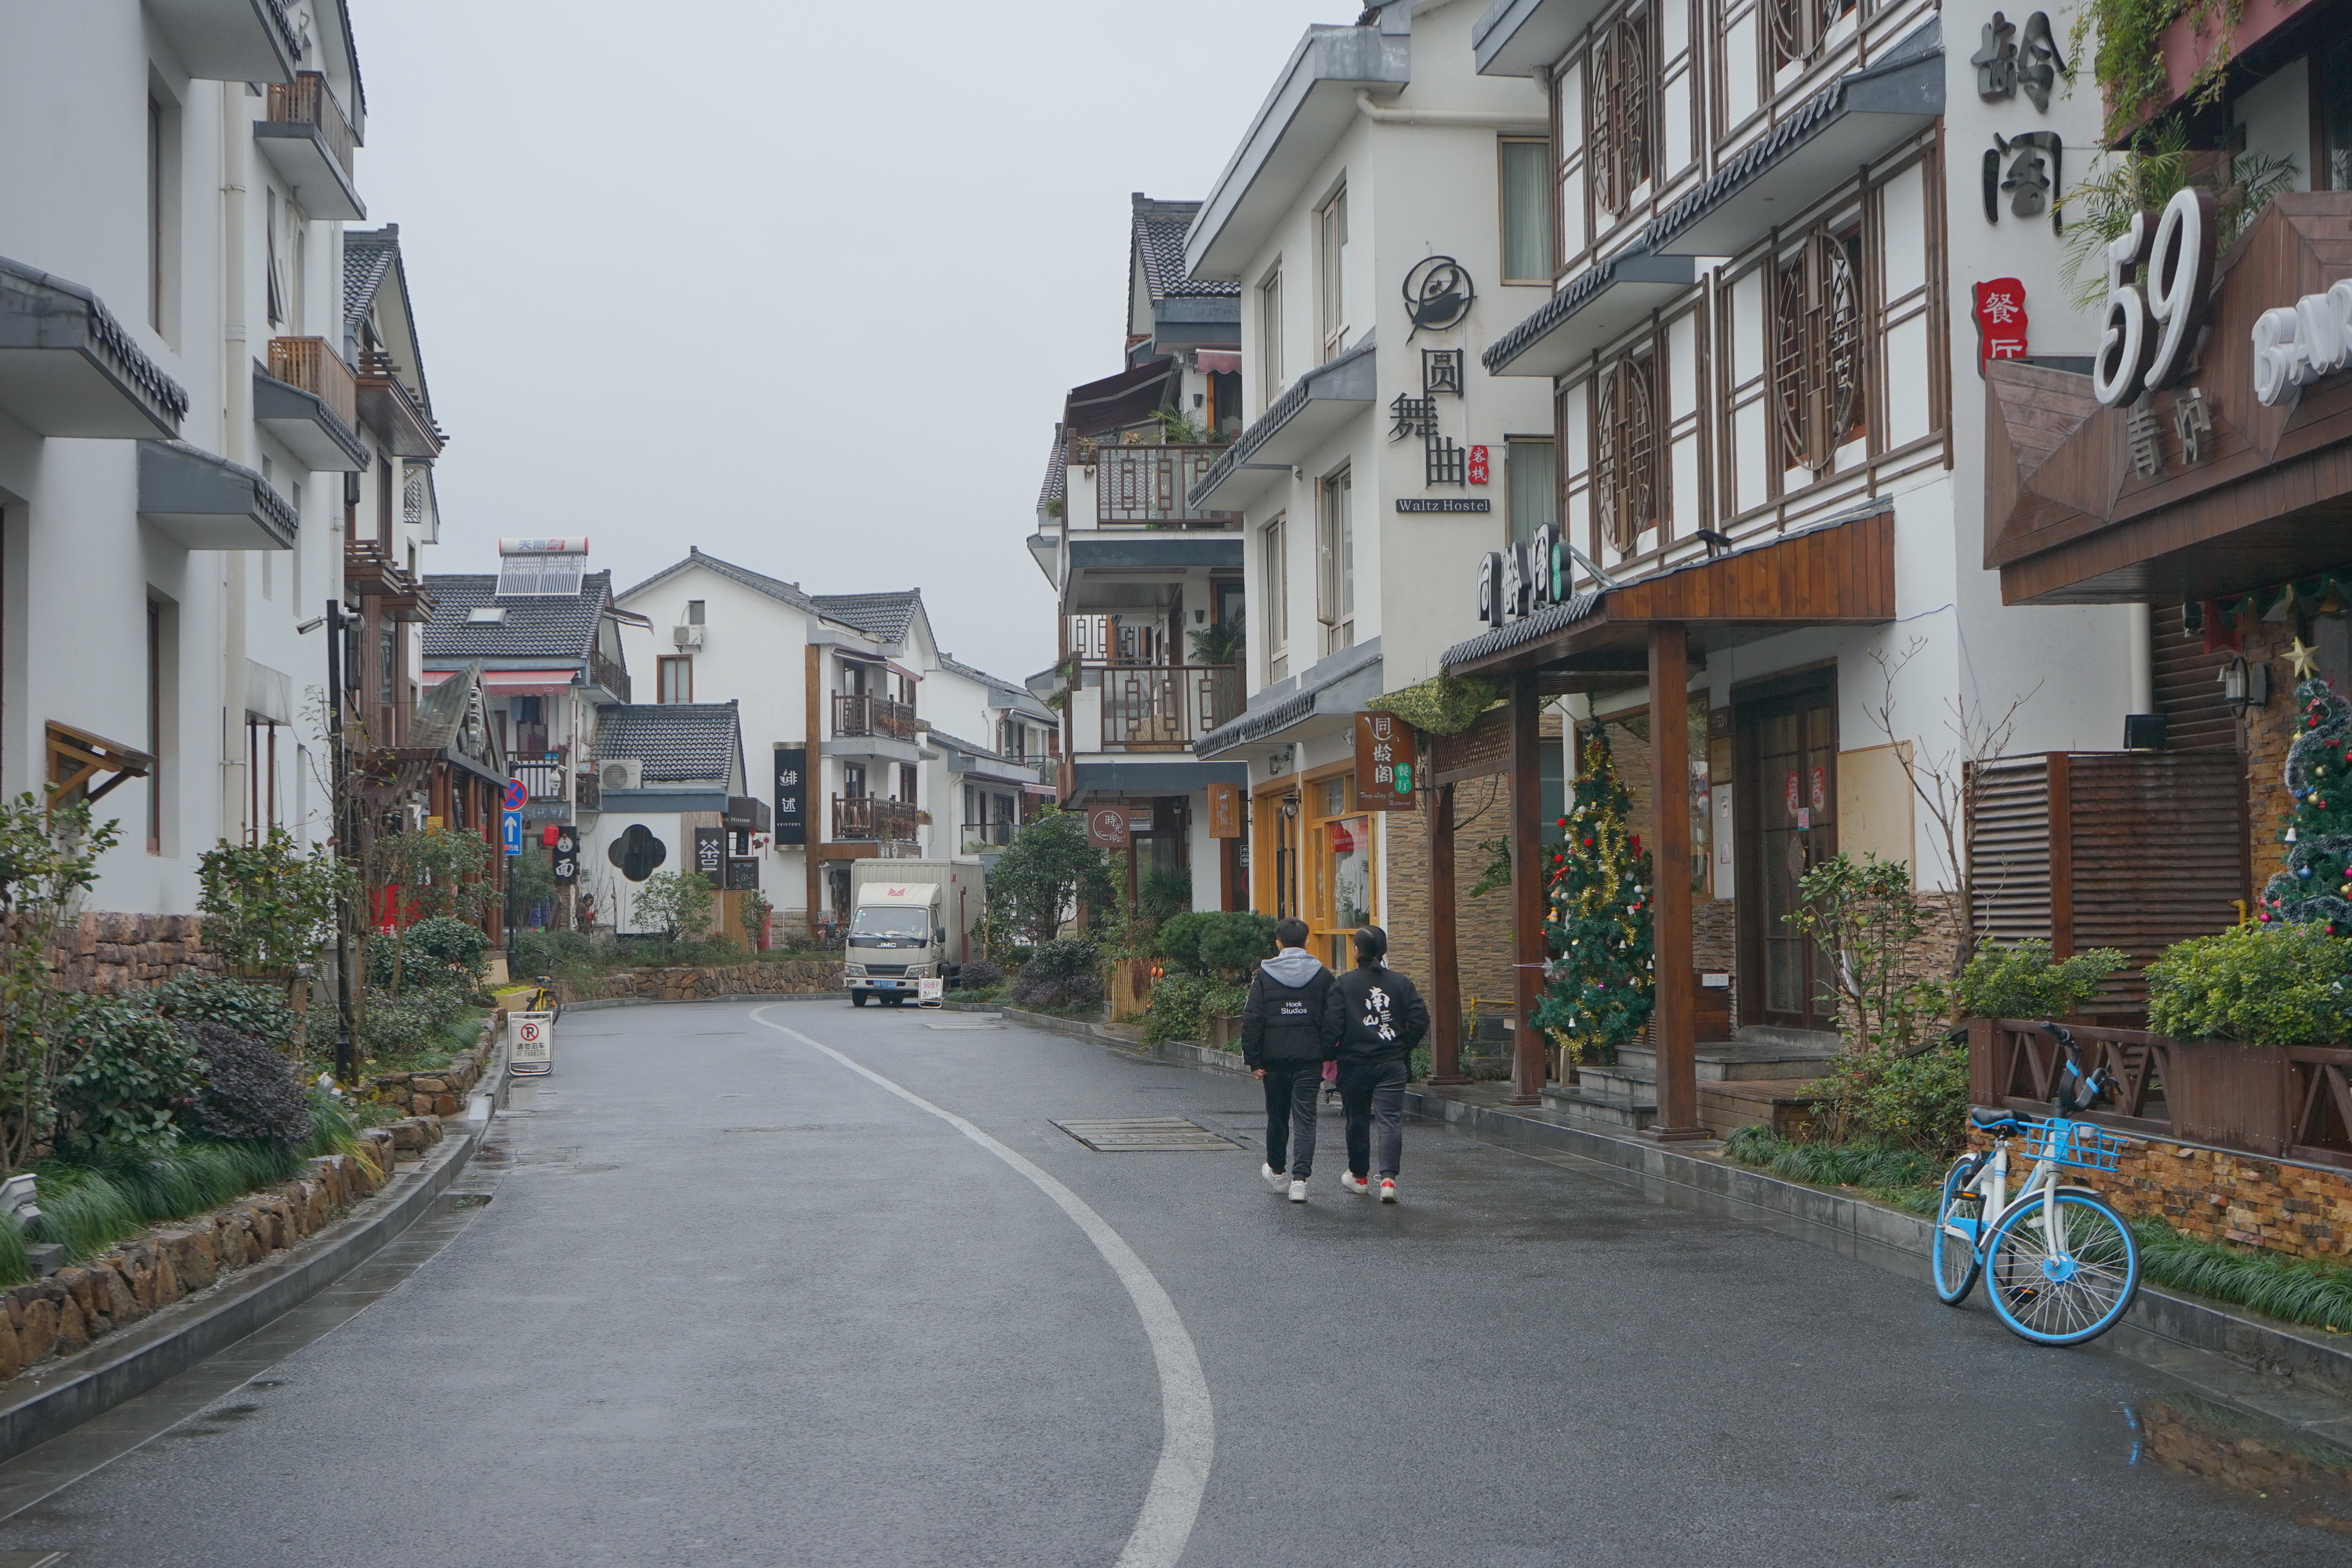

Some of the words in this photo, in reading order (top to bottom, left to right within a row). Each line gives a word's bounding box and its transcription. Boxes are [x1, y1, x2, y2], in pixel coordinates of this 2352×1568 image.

[2093, 187, 2201, 408] 59
[1388, 347, 1466, 488] 圆舞曲
[1472, 447, 1487, 481] 客栈
[1399, 500, 1439, 511] Waltz
[1443, 500, 1489, 511] Hostel
[1365, 717, 1396, 783] 同龄阁
[1363, 986, 1396, 1041] 南山南
